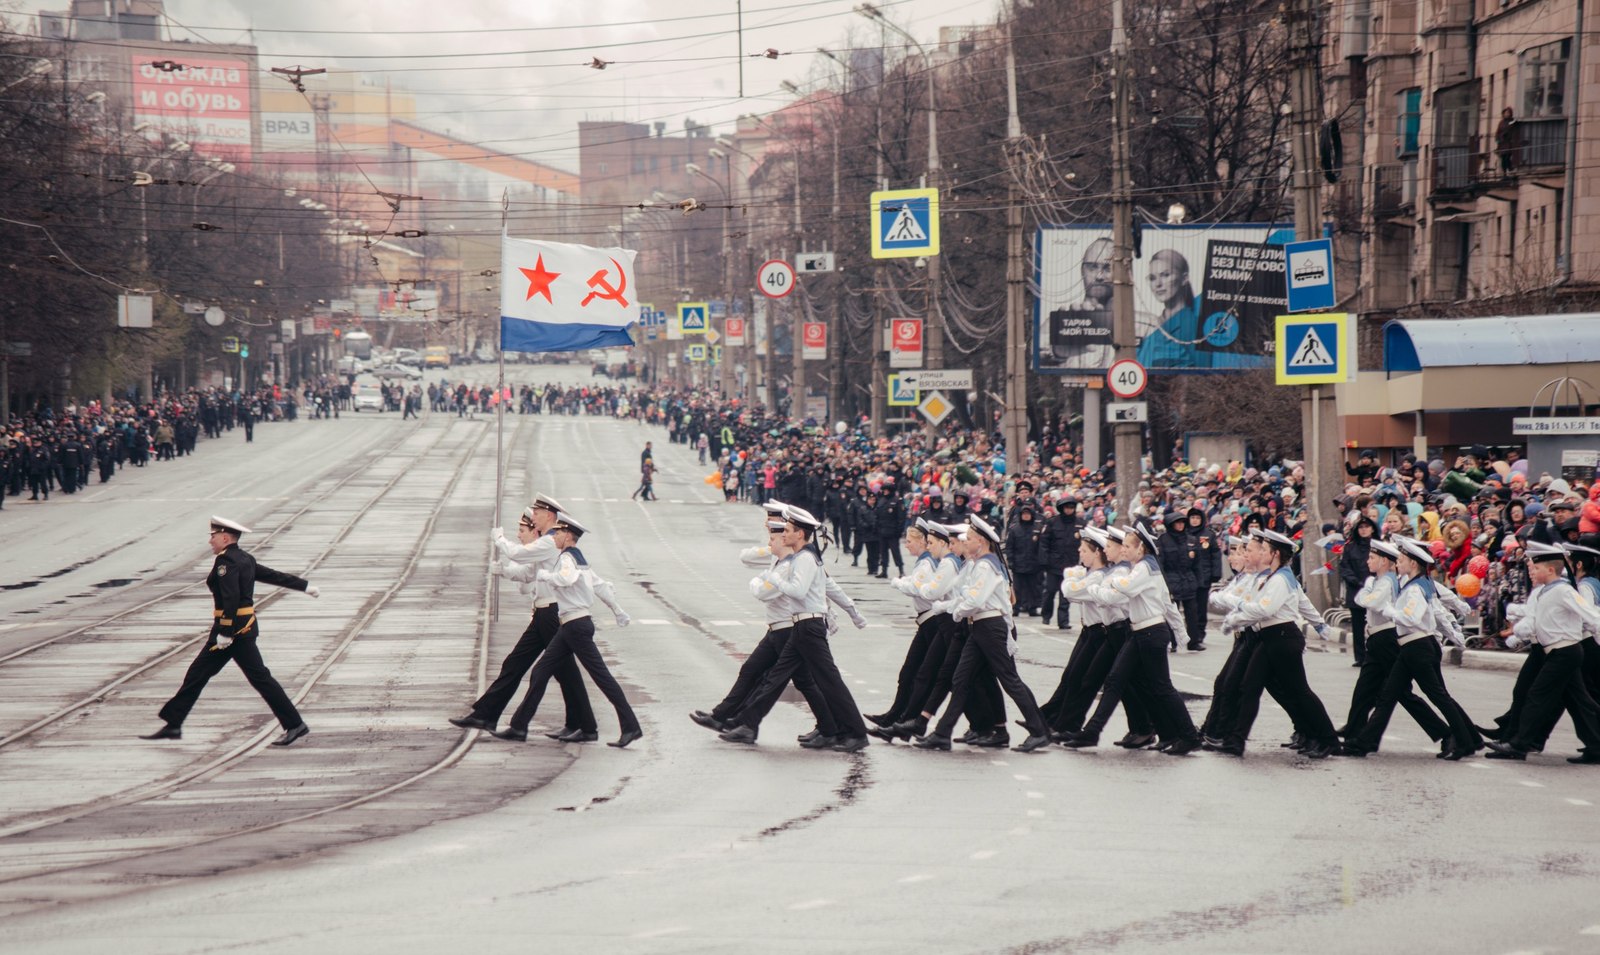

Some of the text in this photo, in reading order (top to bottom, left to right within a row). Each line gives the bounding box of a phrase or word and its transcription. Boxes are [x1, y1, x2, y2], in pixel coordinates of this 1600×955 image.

[141, 87, 241, 113] и обувь
[1212, 245, 1241, 257] НАШ
[1211, 257, 1234, 269] БЕЗ
[766, 272, 786, 287] 40
[1207, 290, 1231, 302] Цена
[1062, 318, 1092, 327] ТАРИФ
[918, 380, 969, 388] ВЯЗОВСКАЯ
[1118, 370, 1137, 386] 40
